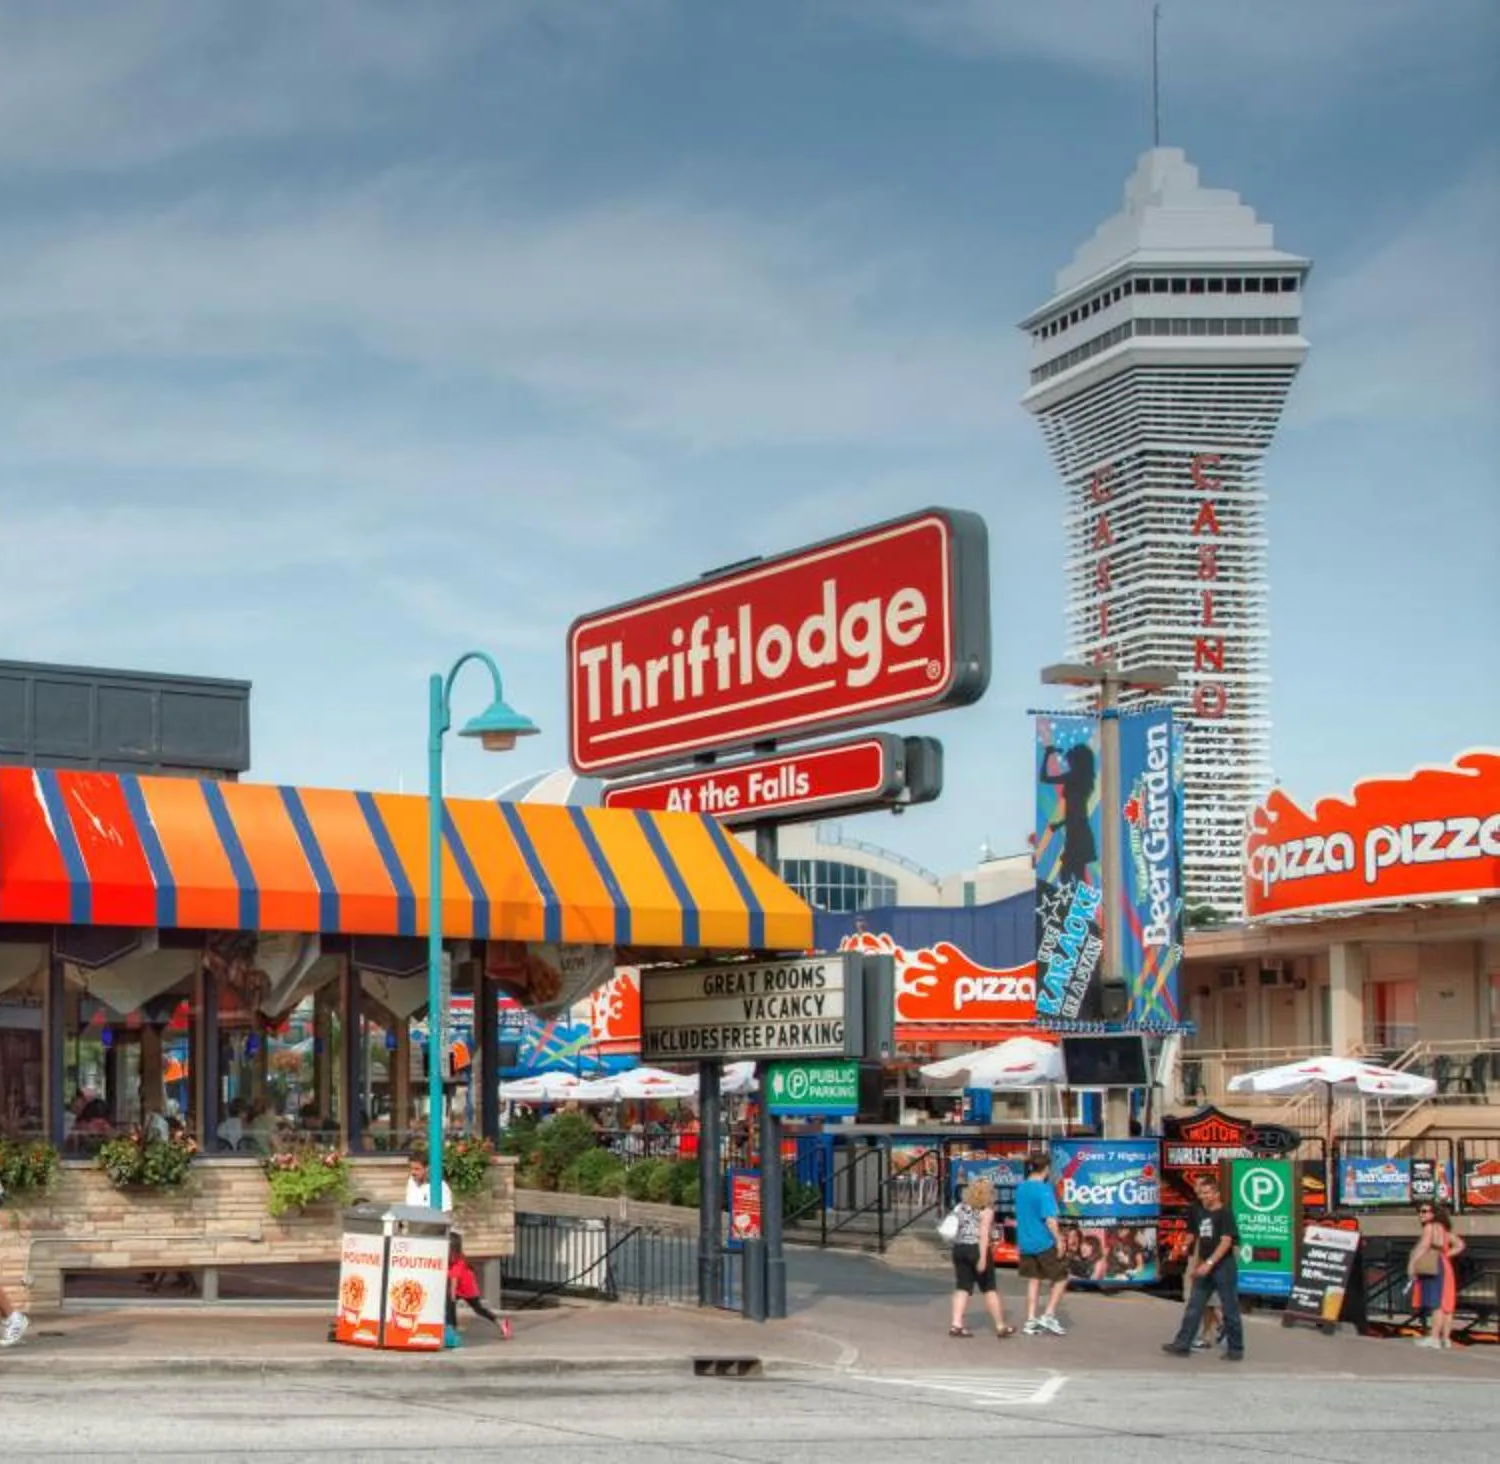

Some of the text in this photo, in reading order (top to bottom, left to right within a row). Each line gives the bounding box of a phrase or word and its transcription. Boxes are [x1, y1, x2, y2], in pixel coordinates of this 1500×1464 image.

[1090, 464, 1116, 708] CASI
[1190, 453, 1228, 719] CASINO
[579, 579, 928, 724] Thriftlodge
[666, 764, 810, 812] At the Falls
[1143, 722, 1172, 947] Beer Garden
[1251, 832, 1356, 898] pizza
[1037, 880, 1103, 1015] KARAOKE
[703, 966, 826, 996] GREAT ROOMS
[954, 976, 1037, 1011] pizza
[742, 994, 825, 1020] VACANCY
[643, 1022, 844, 1052] INCLUDES FREE PARKING
[809, 1069, 856, 1083] PUBLIC
[809, 1085, 856, 1098] PARKING
[1189, 1119, 1240, 1141] MOTOR
[1062, 1178, 1158, 1205] Beer Gar
[1237, 1213, 1289, 1226] PUBLIC
[343, 1251, 381, 1266] POUTINE
[391, 1255, 444, 1271] POUTINE
